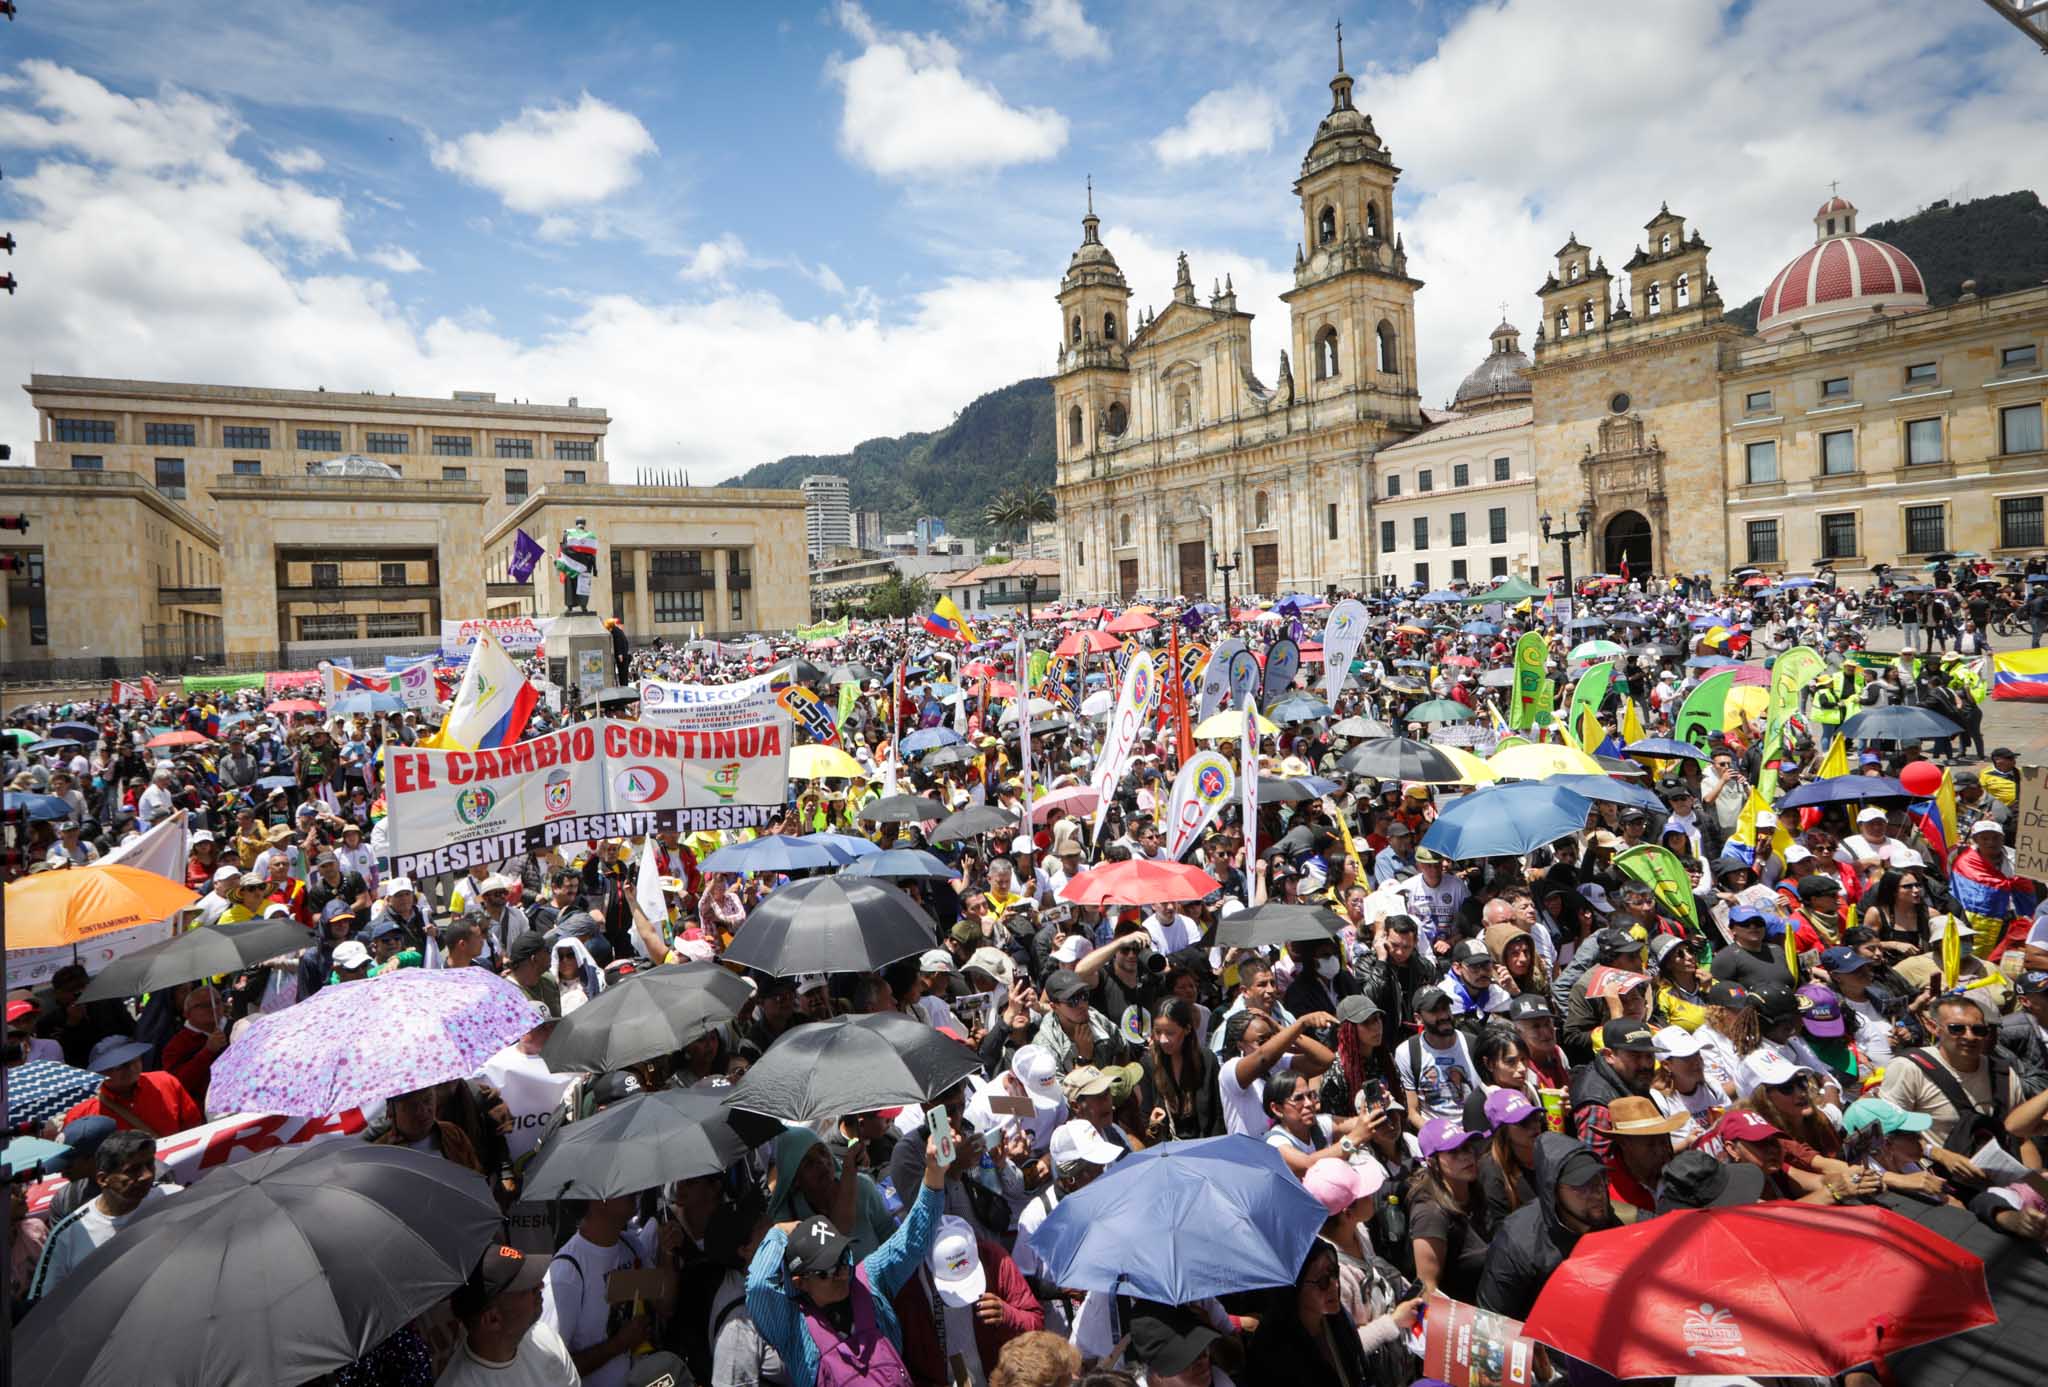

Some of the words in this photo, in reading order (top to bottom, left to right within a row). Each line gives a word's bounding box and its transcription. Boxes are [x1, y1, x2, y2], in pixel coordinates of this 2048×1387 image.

[784, 691, 833, 738] CUT
[394, 753, 436, 794] EL
[445, 726, 595, 785] CAMBIO
[604, 725, 781, 759] CONTINUA
[398, 830, 526, 878] PRESENTE
[544, 812, 657, 848] PRESENTE
